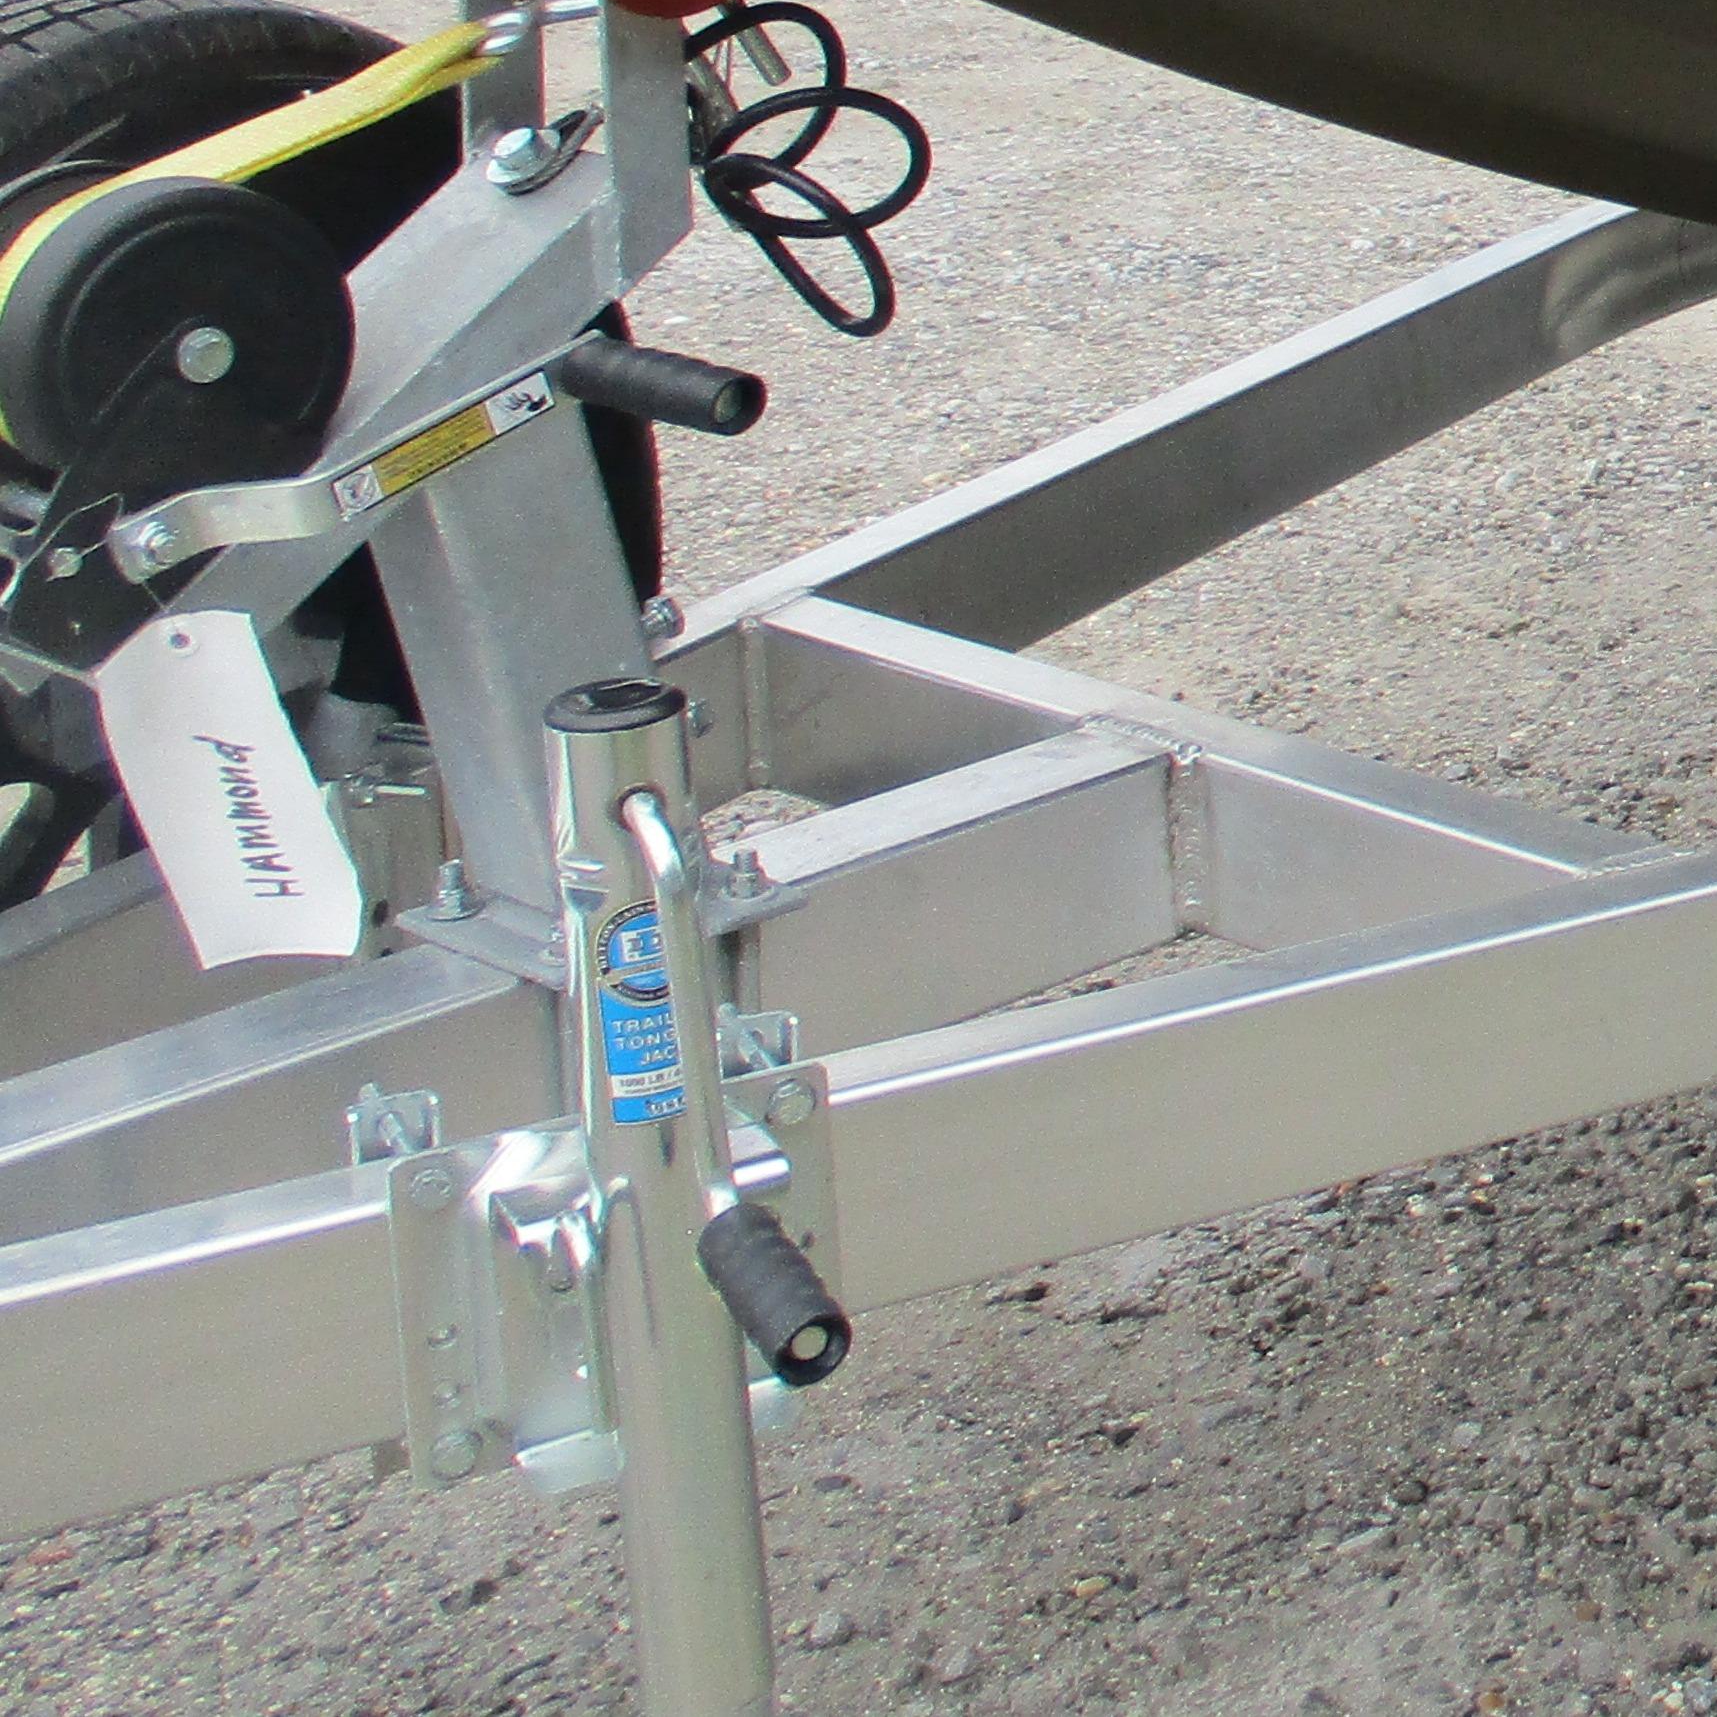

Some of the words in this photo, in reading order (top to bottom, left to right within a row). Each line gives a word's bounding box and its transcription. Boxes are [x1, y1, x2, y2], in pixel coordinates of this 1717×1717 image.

[611, 1012, 673, 1034] TRAIL
[613, 1027, 677, 1050] TONG
[640, 1044, 678, 1065] JAC
